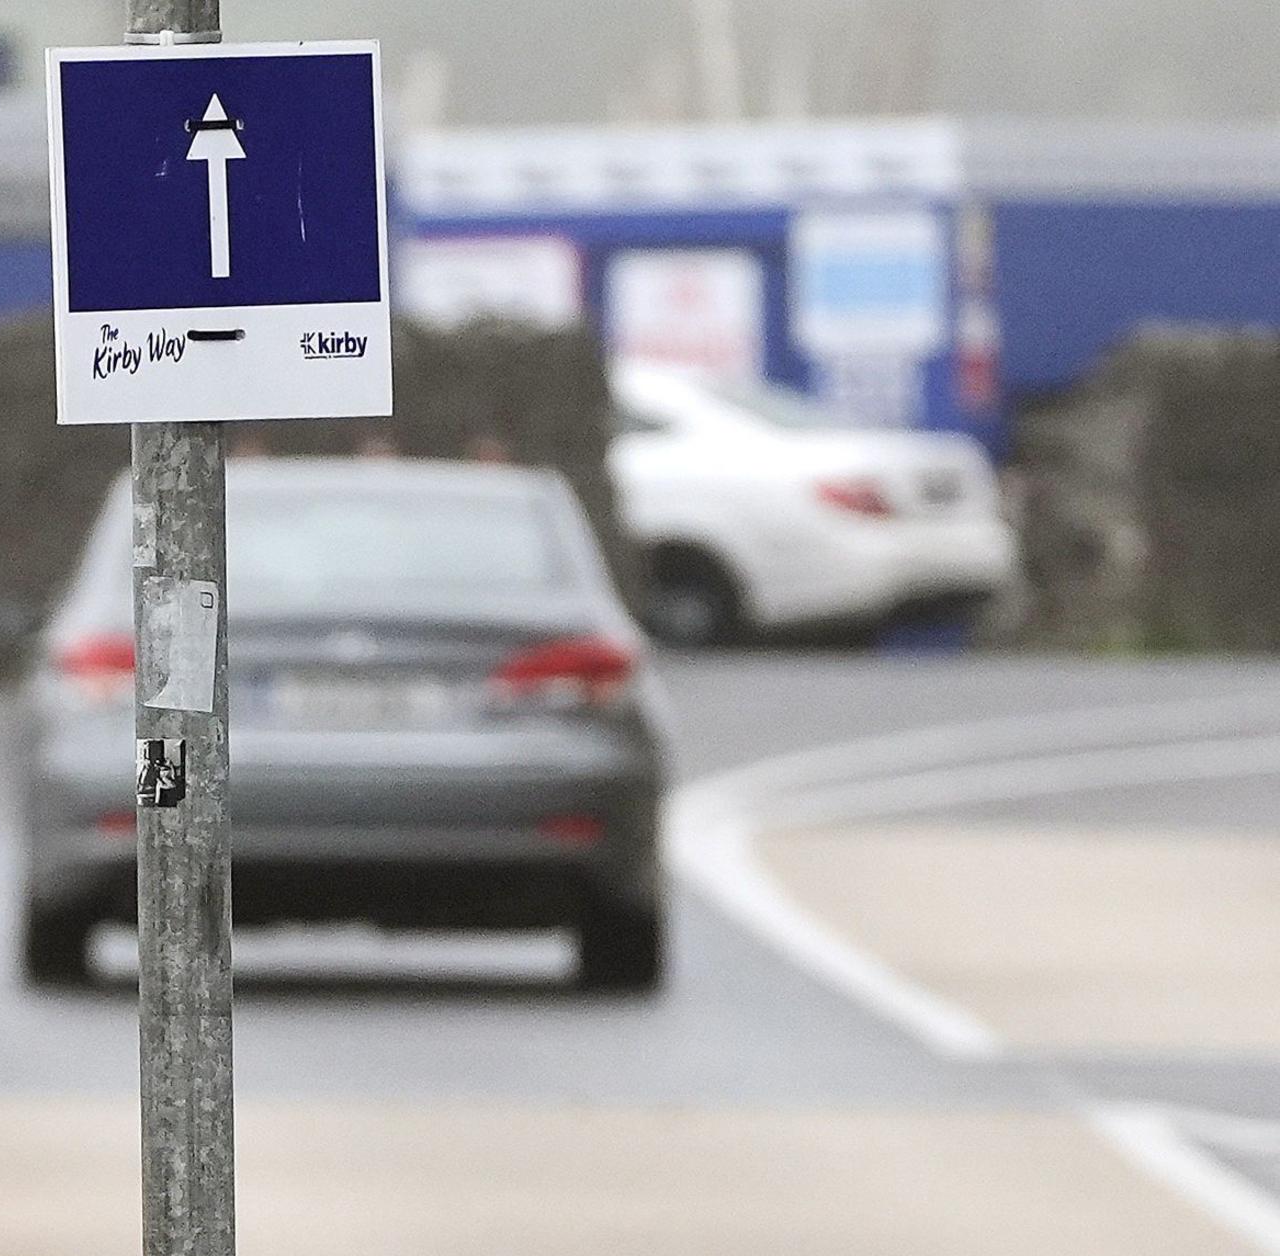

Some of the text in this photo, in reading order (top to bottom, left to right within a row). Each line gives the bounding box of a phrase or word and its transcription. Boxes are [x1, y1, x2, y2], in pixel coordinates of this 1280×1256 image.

[101, 324, 119, 344] The
[318, 331, 368, 358] kirby
[93, 327, 186, 379] Kirby Way
